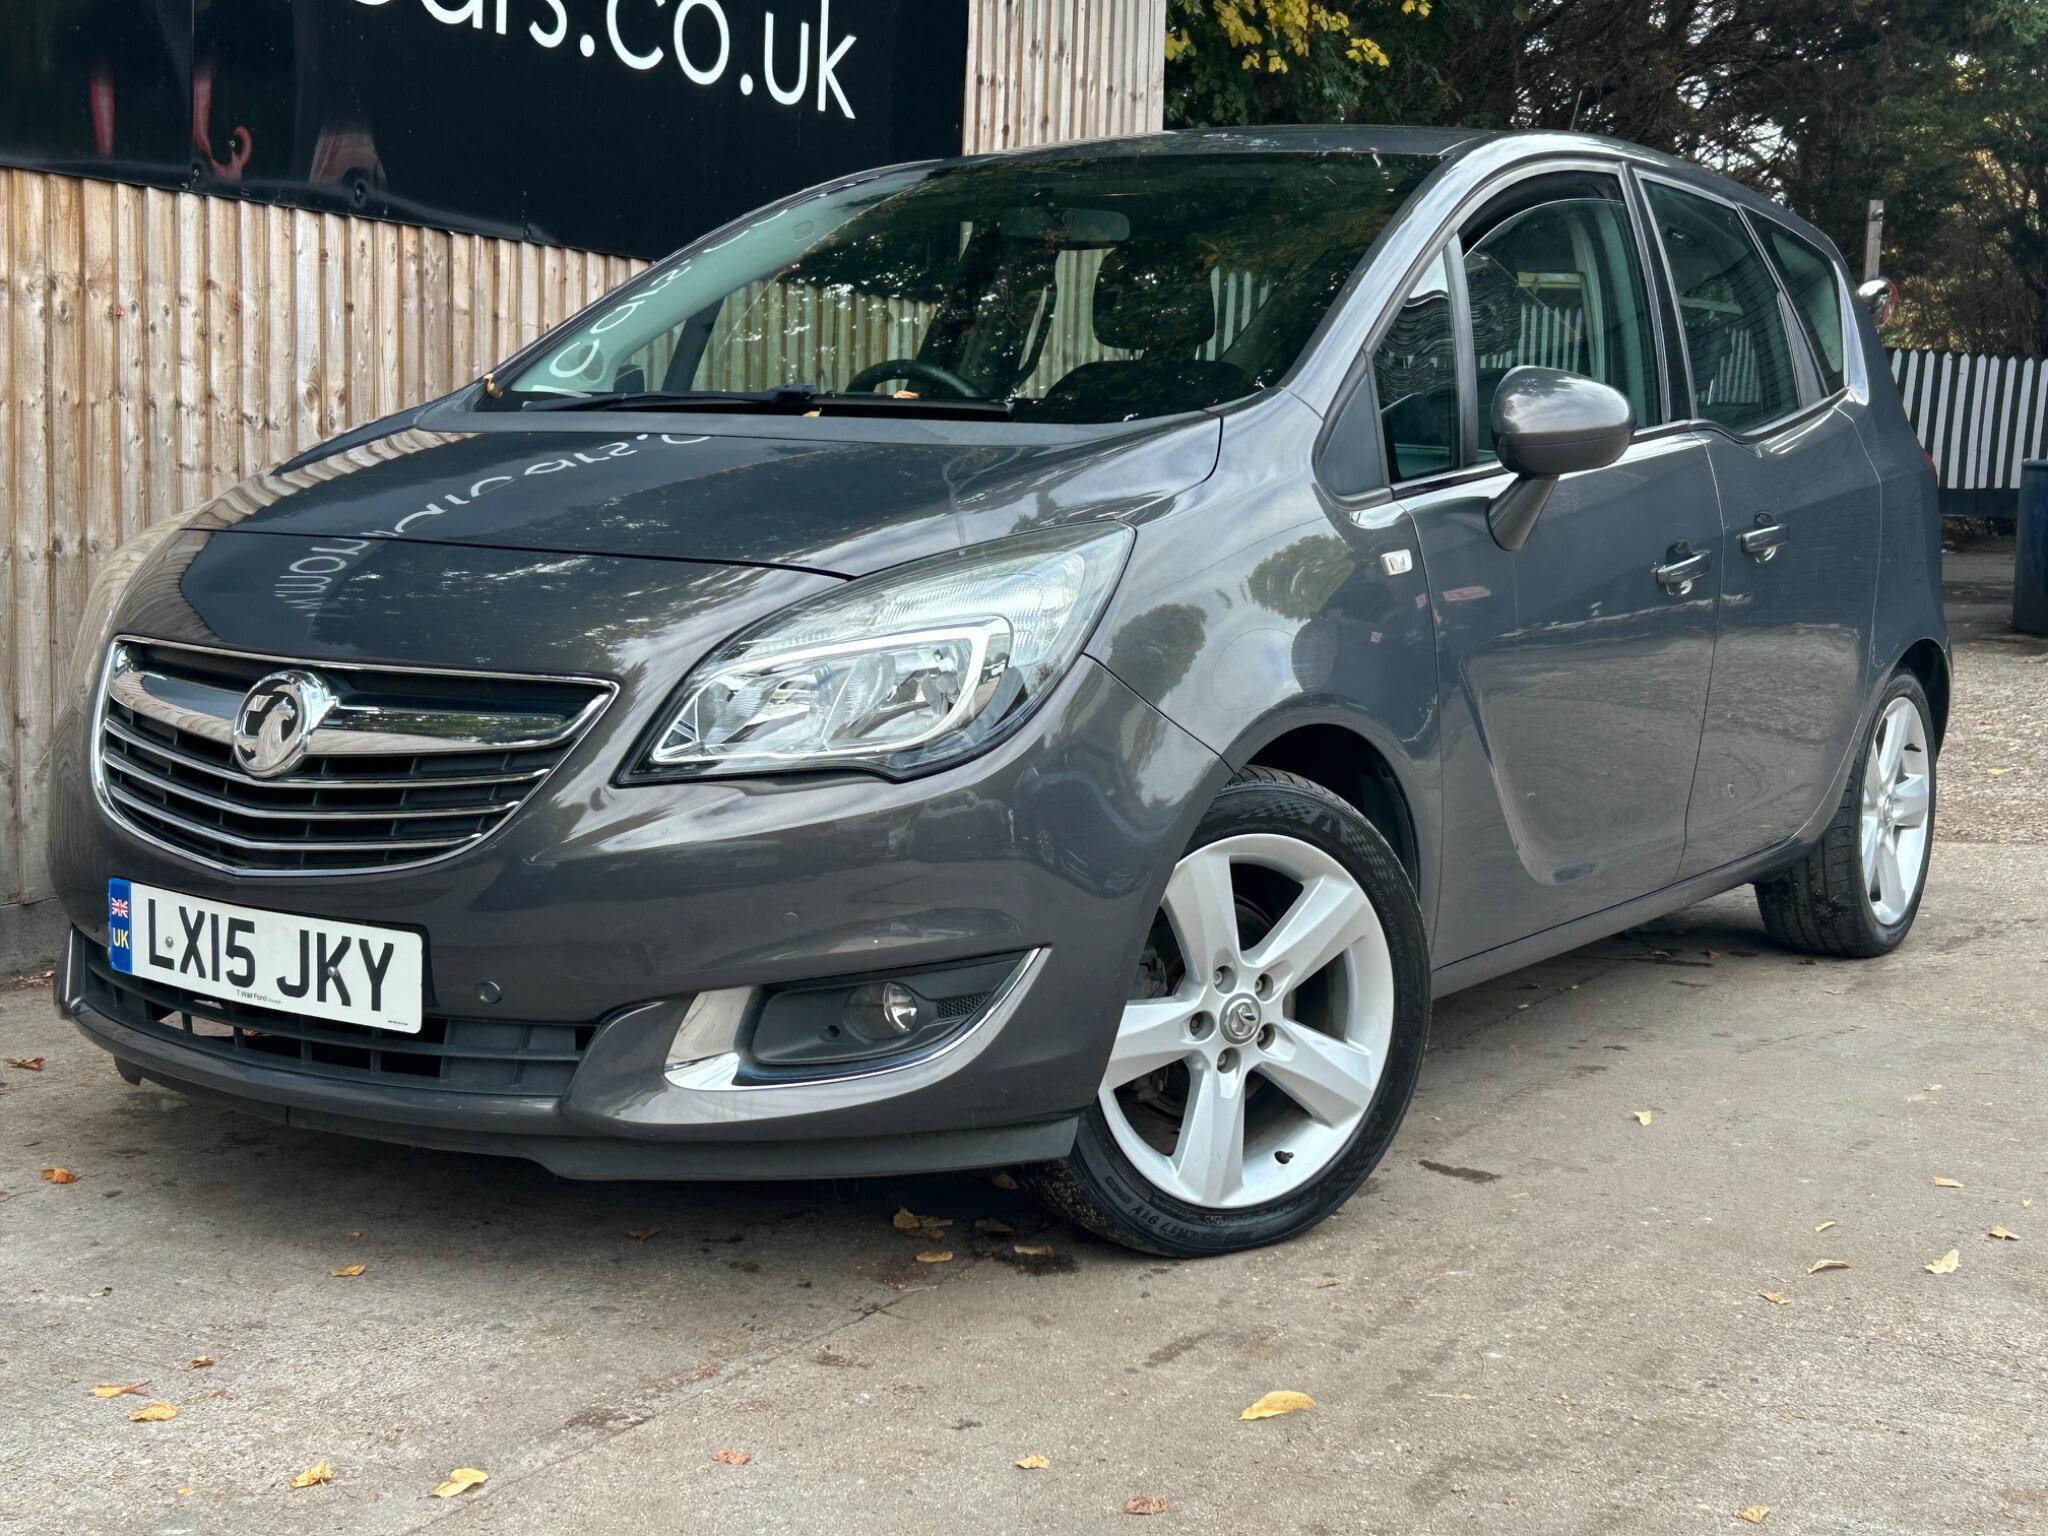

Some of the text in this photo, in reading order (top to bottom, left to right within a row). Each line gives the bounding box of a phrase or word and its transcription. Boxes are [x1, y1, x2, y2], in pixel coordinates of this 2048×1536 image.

[354, 0, 857, 119] s.co.uk
[112, 927, 130, 950] UK
[148, 898, 395, 1012] LX15 JKY
